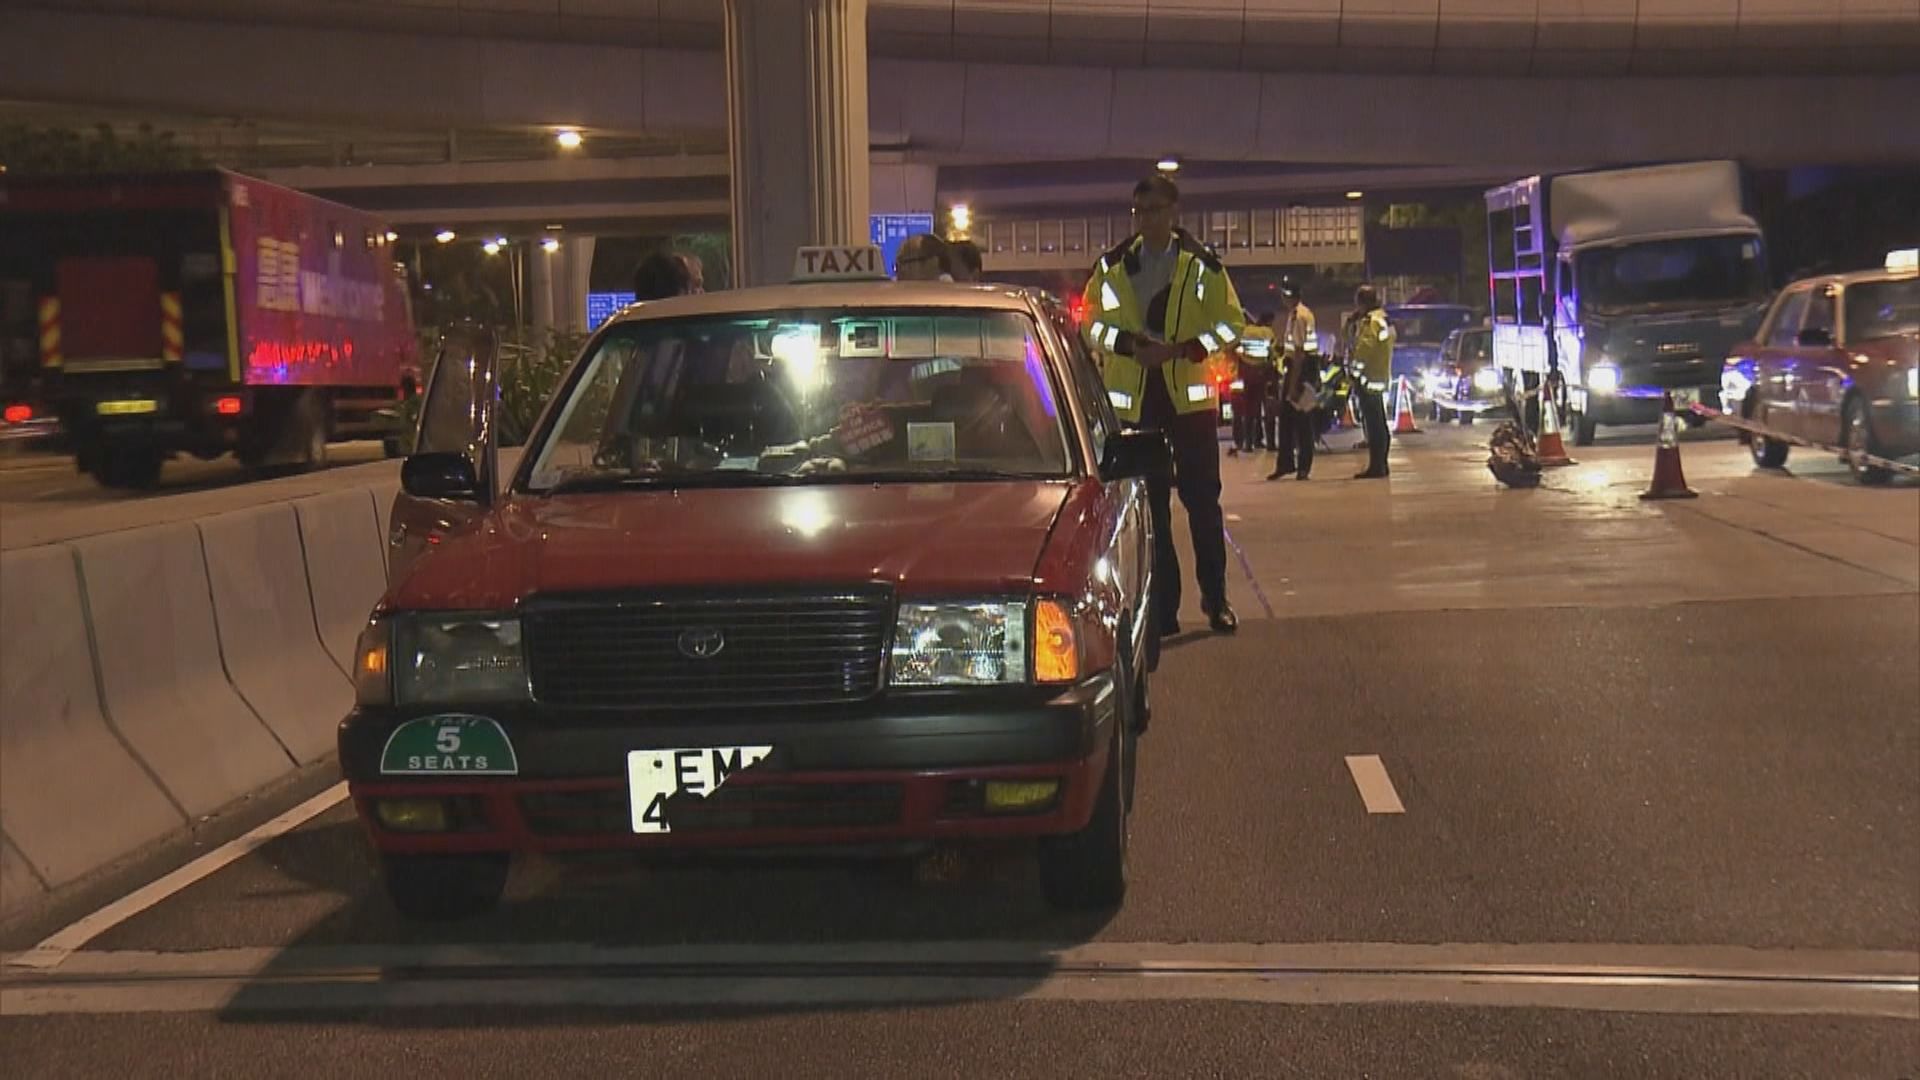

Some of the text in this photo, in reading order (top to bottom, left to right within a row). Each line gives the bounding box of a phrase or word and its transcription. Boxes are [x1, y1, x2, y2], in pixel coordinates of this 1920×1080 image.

[801, 248, 875, 274] TAXI
[436, 726, 460, 753] 5
[408, 756, 488, 770] SEATS
